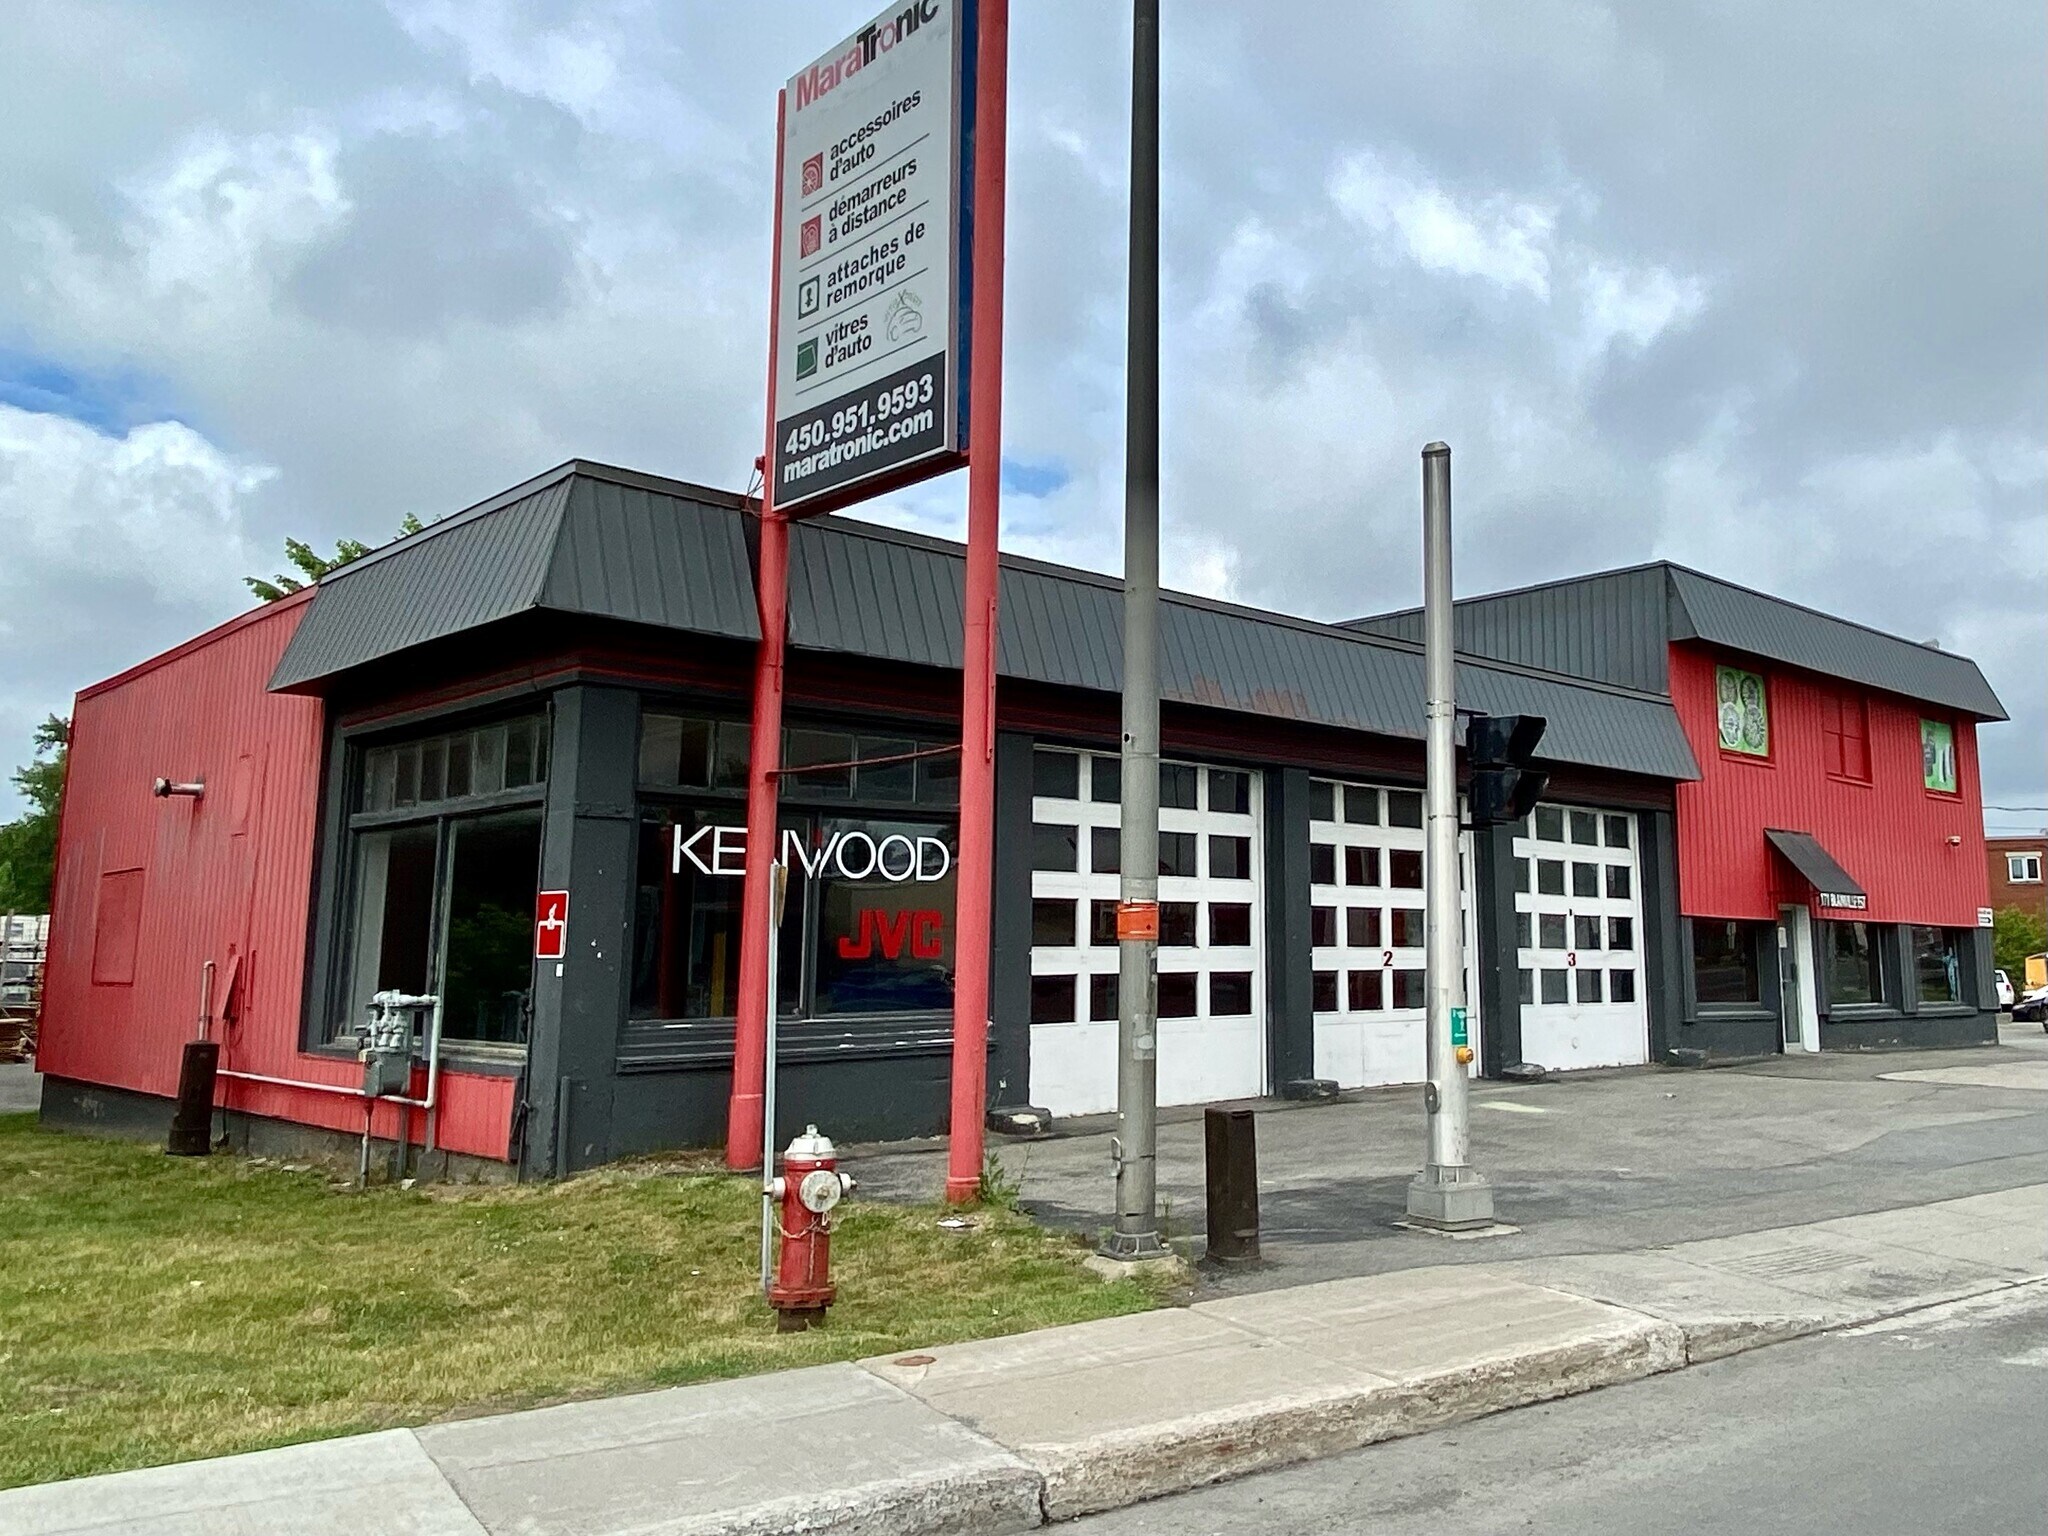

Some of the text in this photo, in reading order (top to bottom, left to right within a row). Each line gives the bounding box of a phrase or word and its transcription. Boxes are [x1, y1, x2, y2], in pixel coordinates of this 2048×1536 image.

[796, 0, 939, 112] MaraTronic
[830, 90, 921, 160] accessoires
[829, 158, 917, 221] démarreurs
[830, 143, 875, 181] d'auto
[828, 188, 907, 243] à distance
[826, 254, 906, 307] remorque
[827, 221, 925, 288] attaches de
[825, 314, 868, 347] vitres
[825, 334, 872, 368] d'auto
[785, 374, 933, 455] 450.951.9593
[783, 409, 933, 483] maratronic.com
[672, 824, 950, 881] KEWOOD
[838, 909, 943, 959] JVC
[1383, 951, 1393, 967] 2
[1567, 952, 1577, 967] 3
